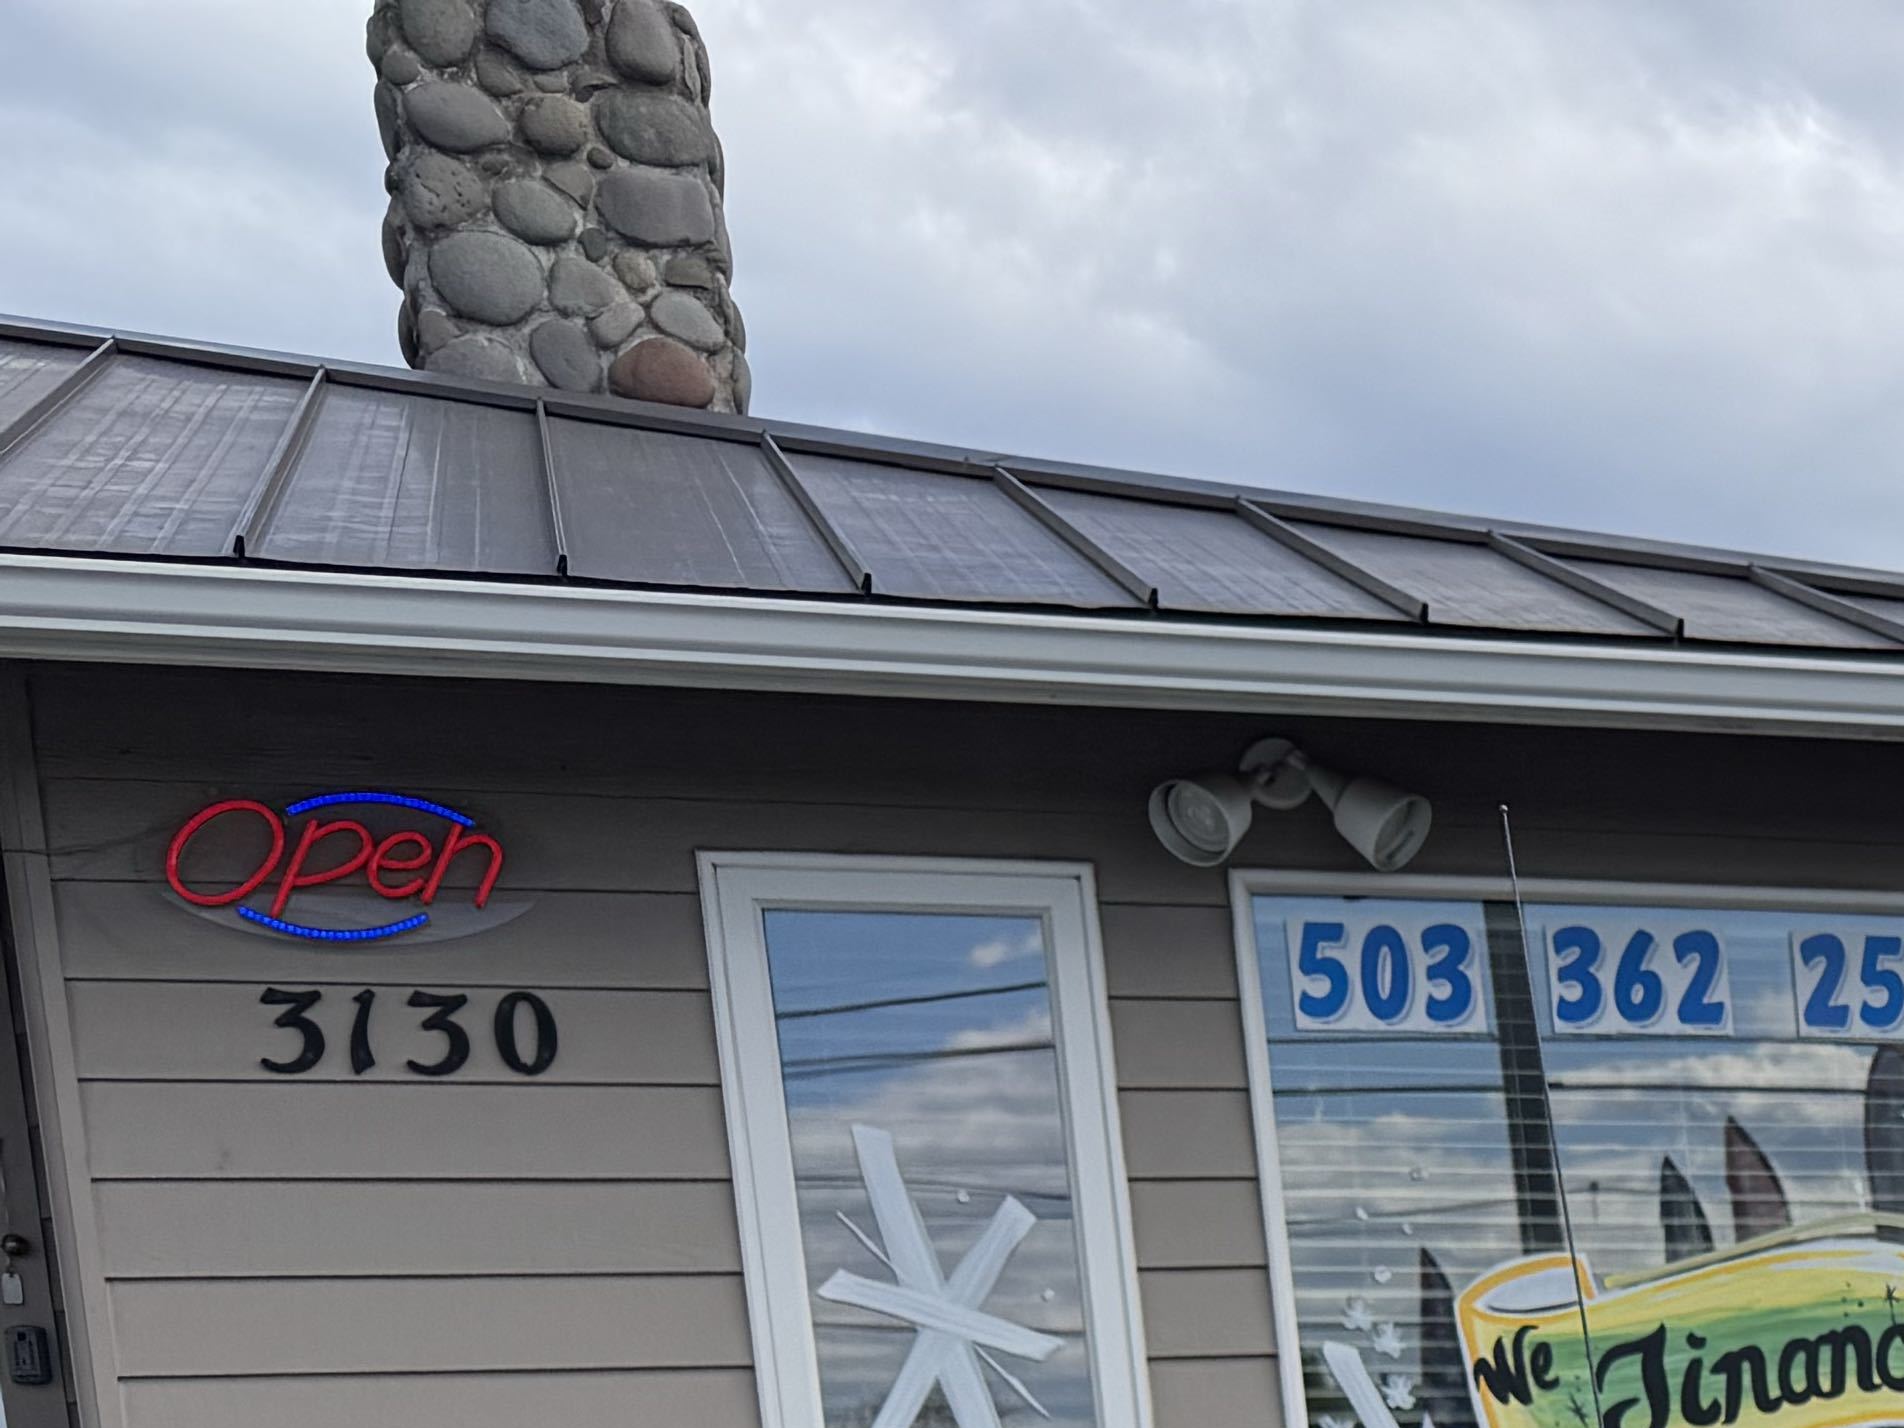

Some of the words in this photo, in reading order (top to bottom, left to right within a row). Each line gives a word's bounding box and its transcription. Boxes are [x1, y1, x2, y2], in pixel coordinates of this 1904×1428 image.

[165, 799, 505, 917] Open
[1296, 921, 1476, 1023] 503
[1552, 925, 1727, 1029] 362
[259, 986, 559, 1076] 3130
[1473, 1326, 1560, 1407] We
